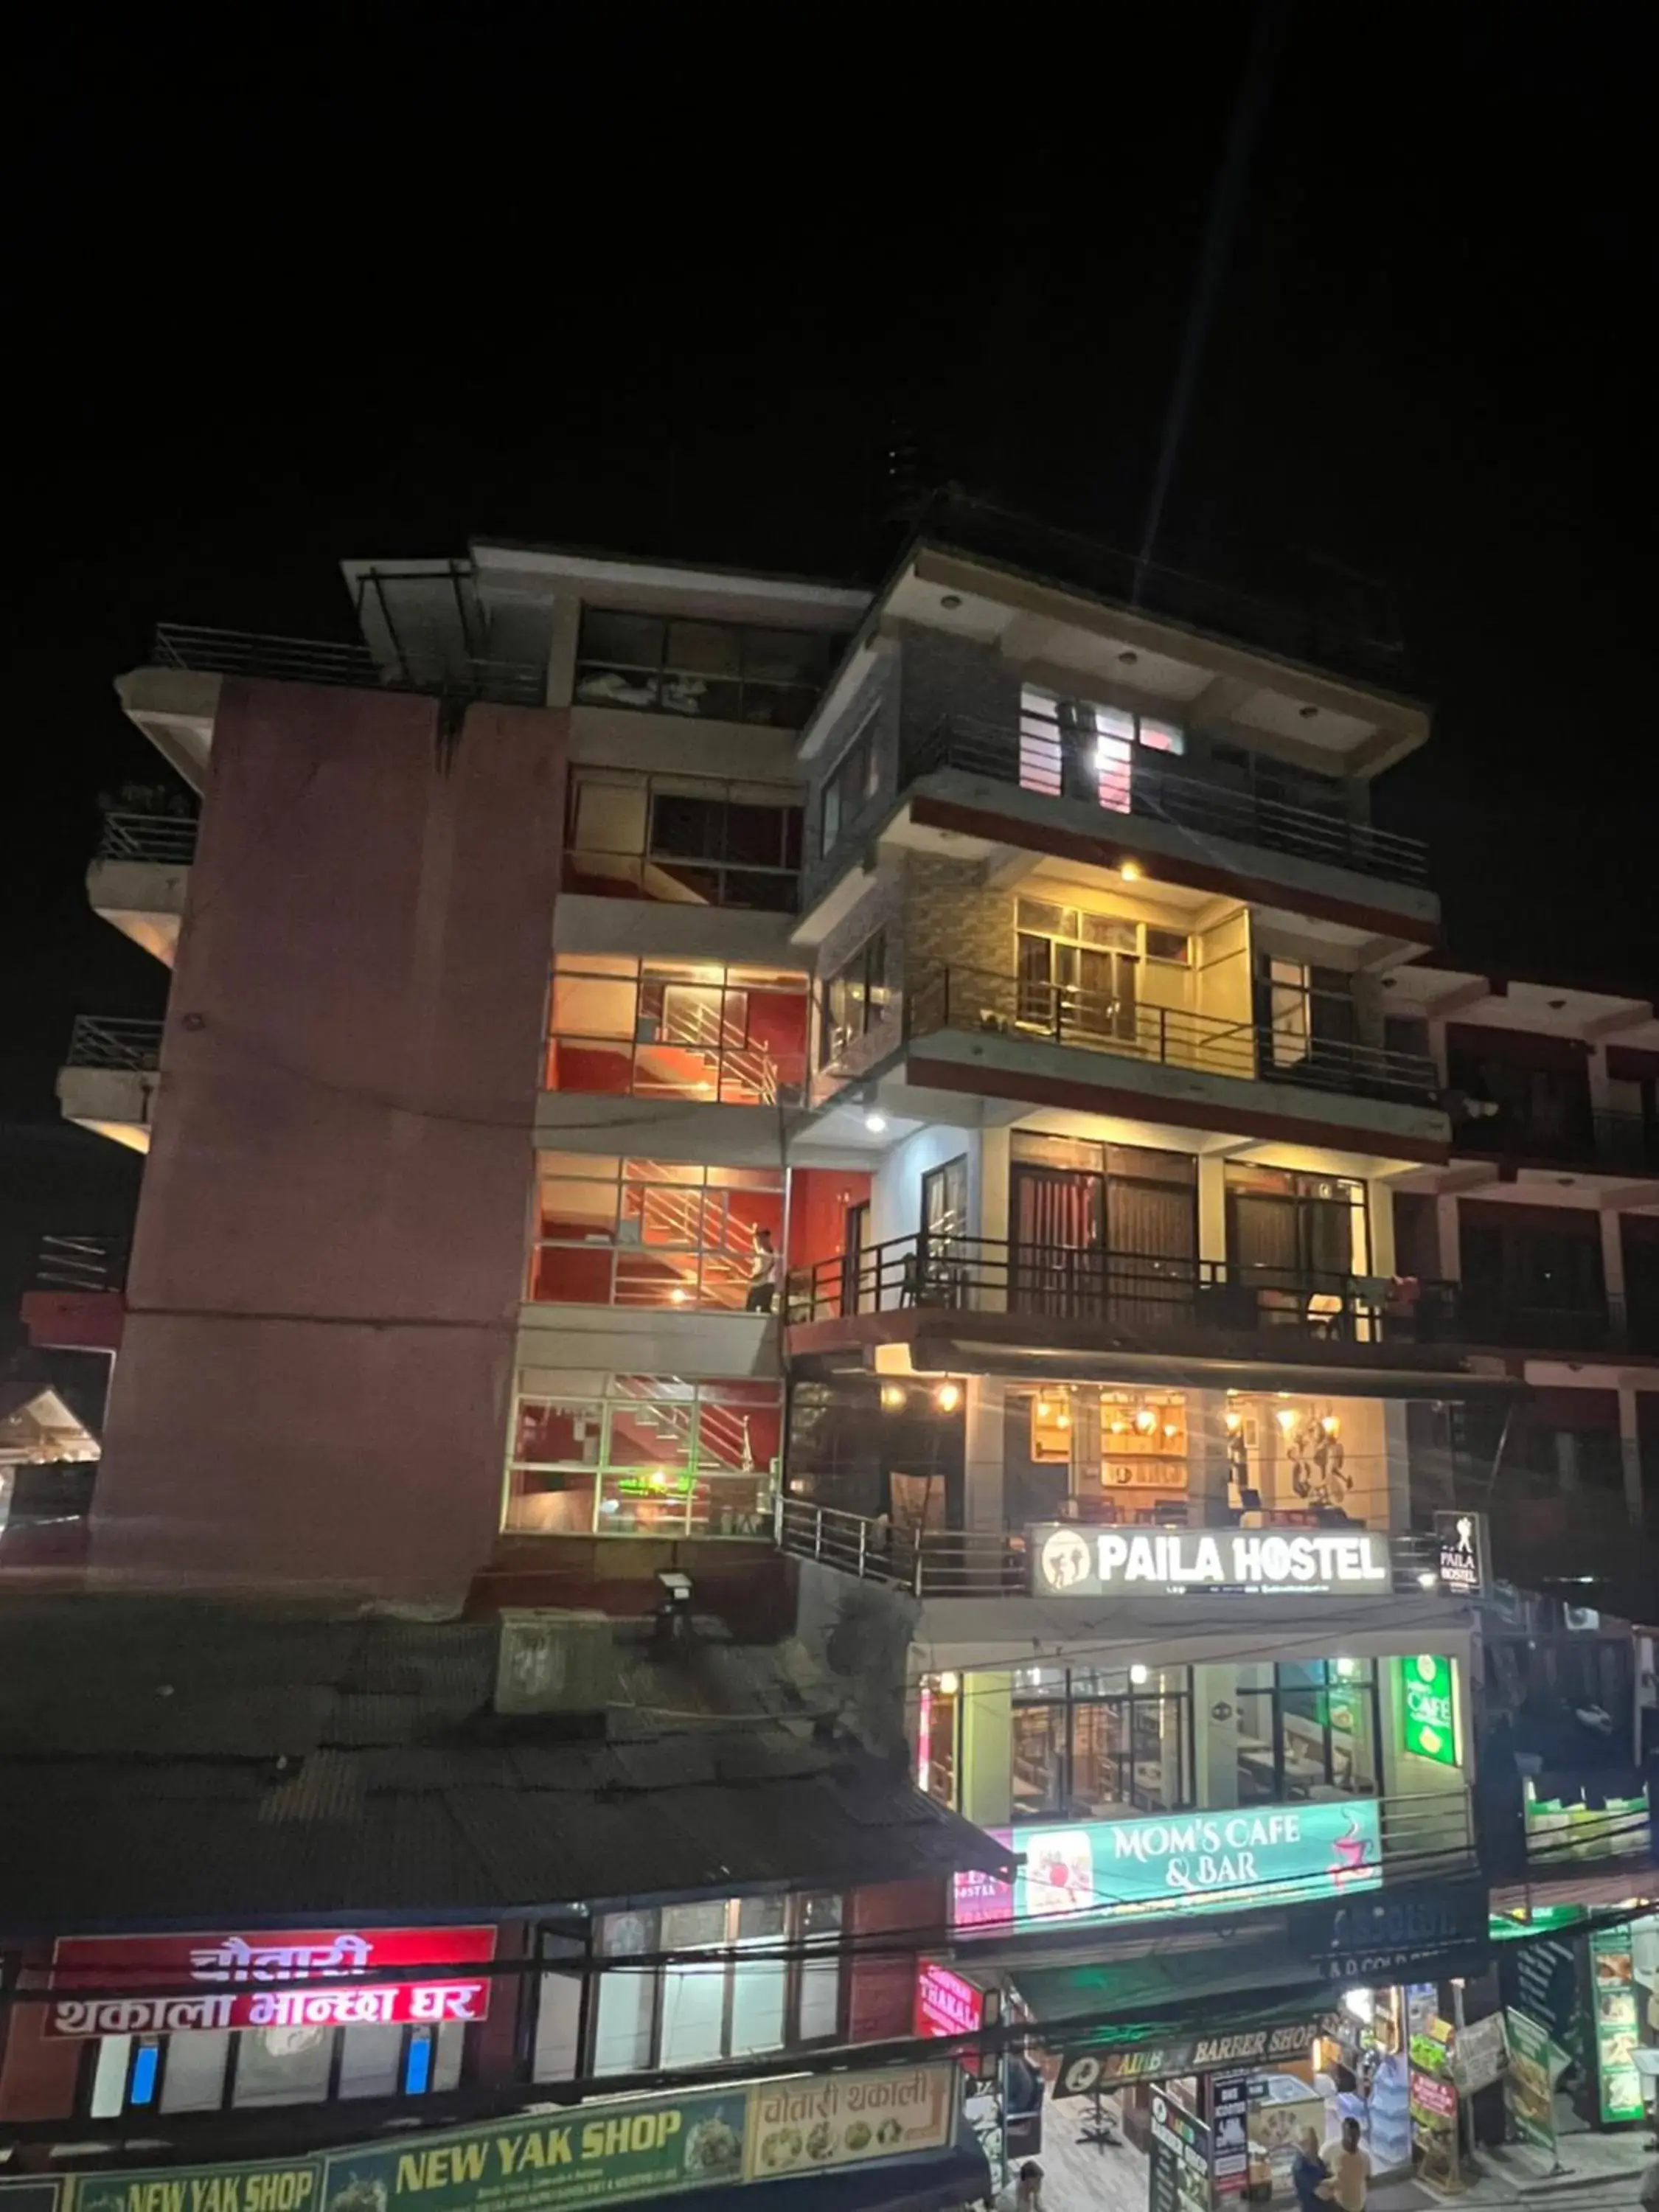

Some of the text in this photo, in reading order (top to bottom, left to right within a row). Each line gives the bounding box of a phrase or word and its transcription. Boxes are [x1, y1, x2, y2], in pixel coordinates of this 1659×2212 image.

[1097, 1535, 1386, 1582] PAILA HOSTEL
[1440, 1551, 1475, 1570] PAILA
[1440, 1567, 1477, 1584] HOSTEL
[1407, 1691, 1452, 1721] CAFE
[1111, 1814, 1301, 1863] MOM'S CAFE
[1165, 1851, 1259, 1892] & BAR
[410, 1983, 482, 2020] घर
[1193, 2031, 1267, 2064] BARBER
[1268, 2024, 1318, 2052] SHOP
[847, 2070, 928, 2112] थकाली
[395, 2140, 490, 2195] NEW
[495, 2125, 573, 2176] YAK
[581, 2110, 683, 2160] SHOP
[128, 2170, 313, 2212] NEW YAK SHOP
